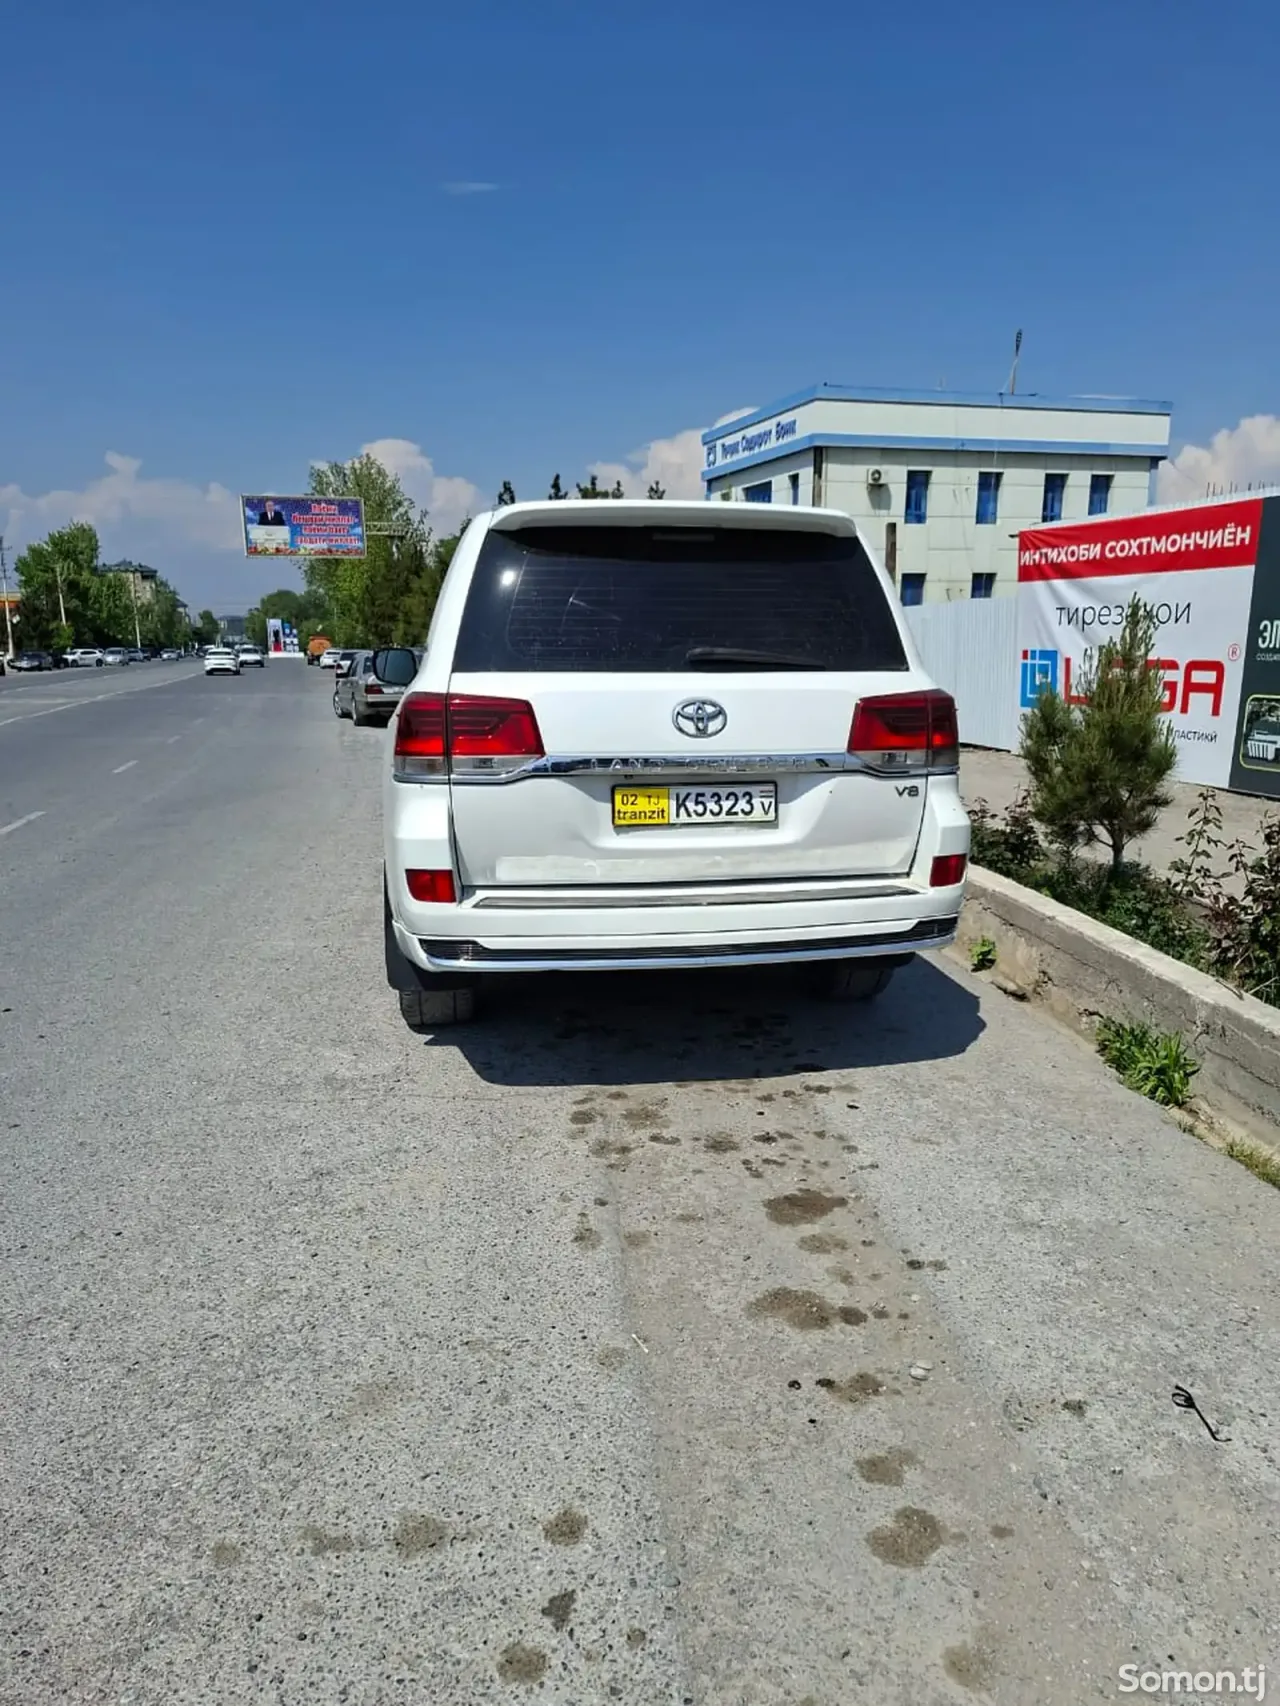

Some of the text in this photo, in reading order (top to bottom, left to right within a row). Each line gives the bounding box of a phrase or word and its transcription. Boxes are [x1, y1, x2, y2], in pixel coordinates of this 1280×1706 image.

[1020, 523, 1251, 566] ИНТИХОБИ СОХТМОНЧИЁН
[1056, 601, 1192, 632] тирезои
[1064, 656, 1225, 717] LGA
[621, 793, 660, 806] 02 TJ
[895, 785, 919, 797] V8
[617, 807, 666, 821] tranzit
[675, 791, 754, 819] K5323
[761, 801, 773, 816] V
